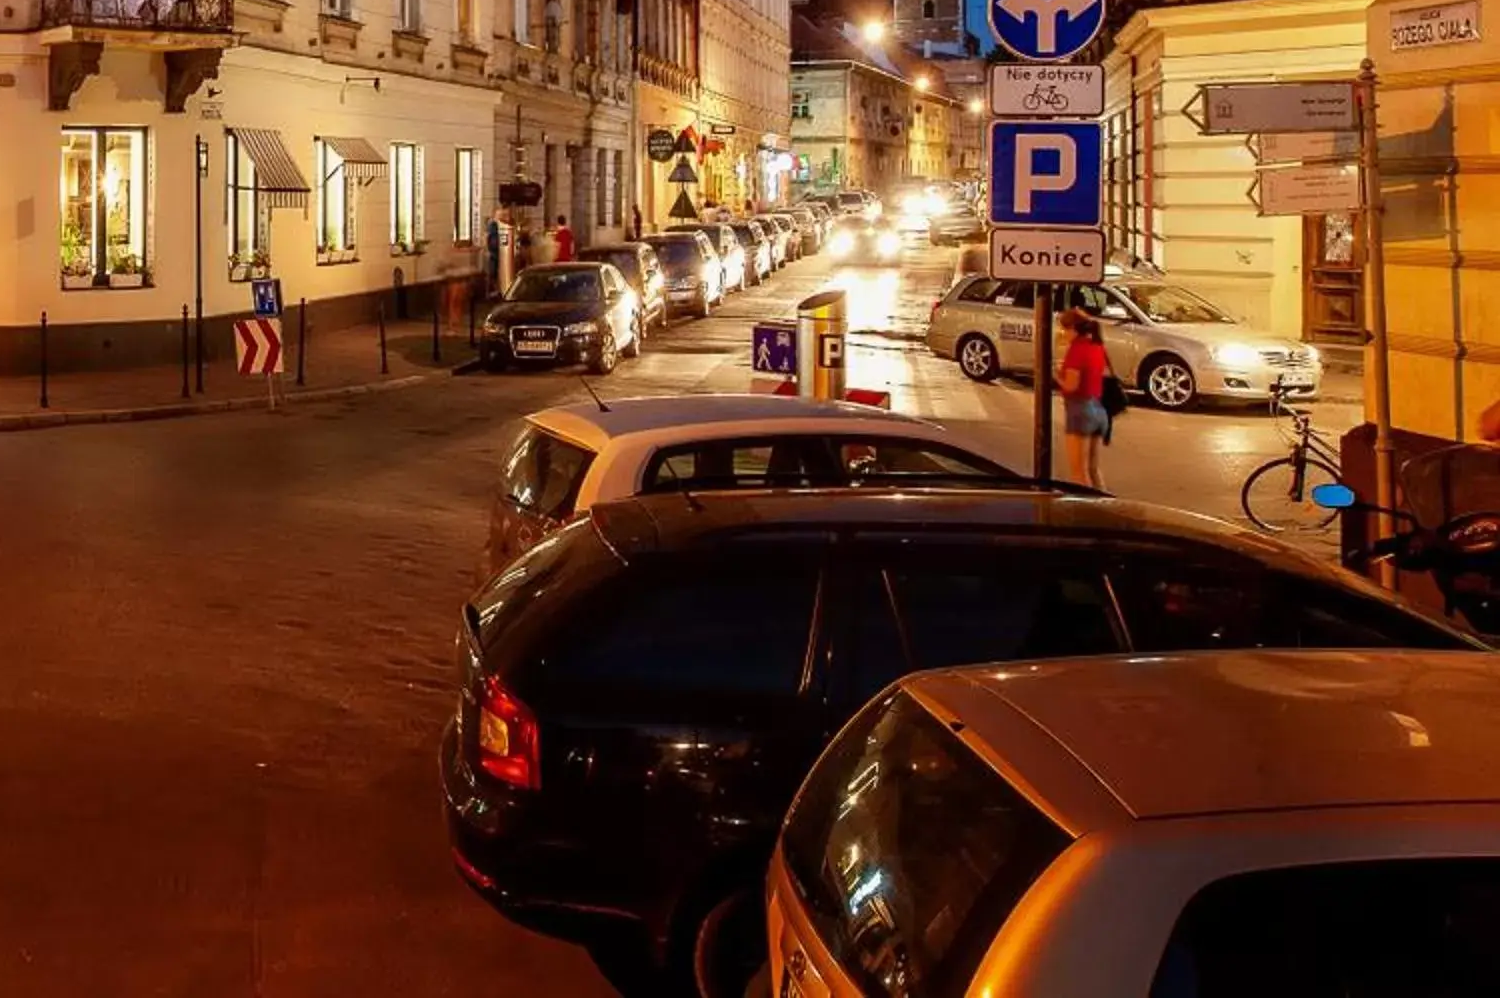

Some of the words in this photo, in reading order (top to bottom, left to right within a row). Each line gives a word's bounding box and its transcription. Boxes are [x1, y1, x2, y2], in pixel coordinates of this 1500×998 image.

[1007, 68, 1031, 81] Nie
[1037, 67, 1093, 83] dotyczy
[1013, 133, 1077, 214] P
[1001, 244, 1093, 267] Koniec
[823, 337, 842, 366] P
